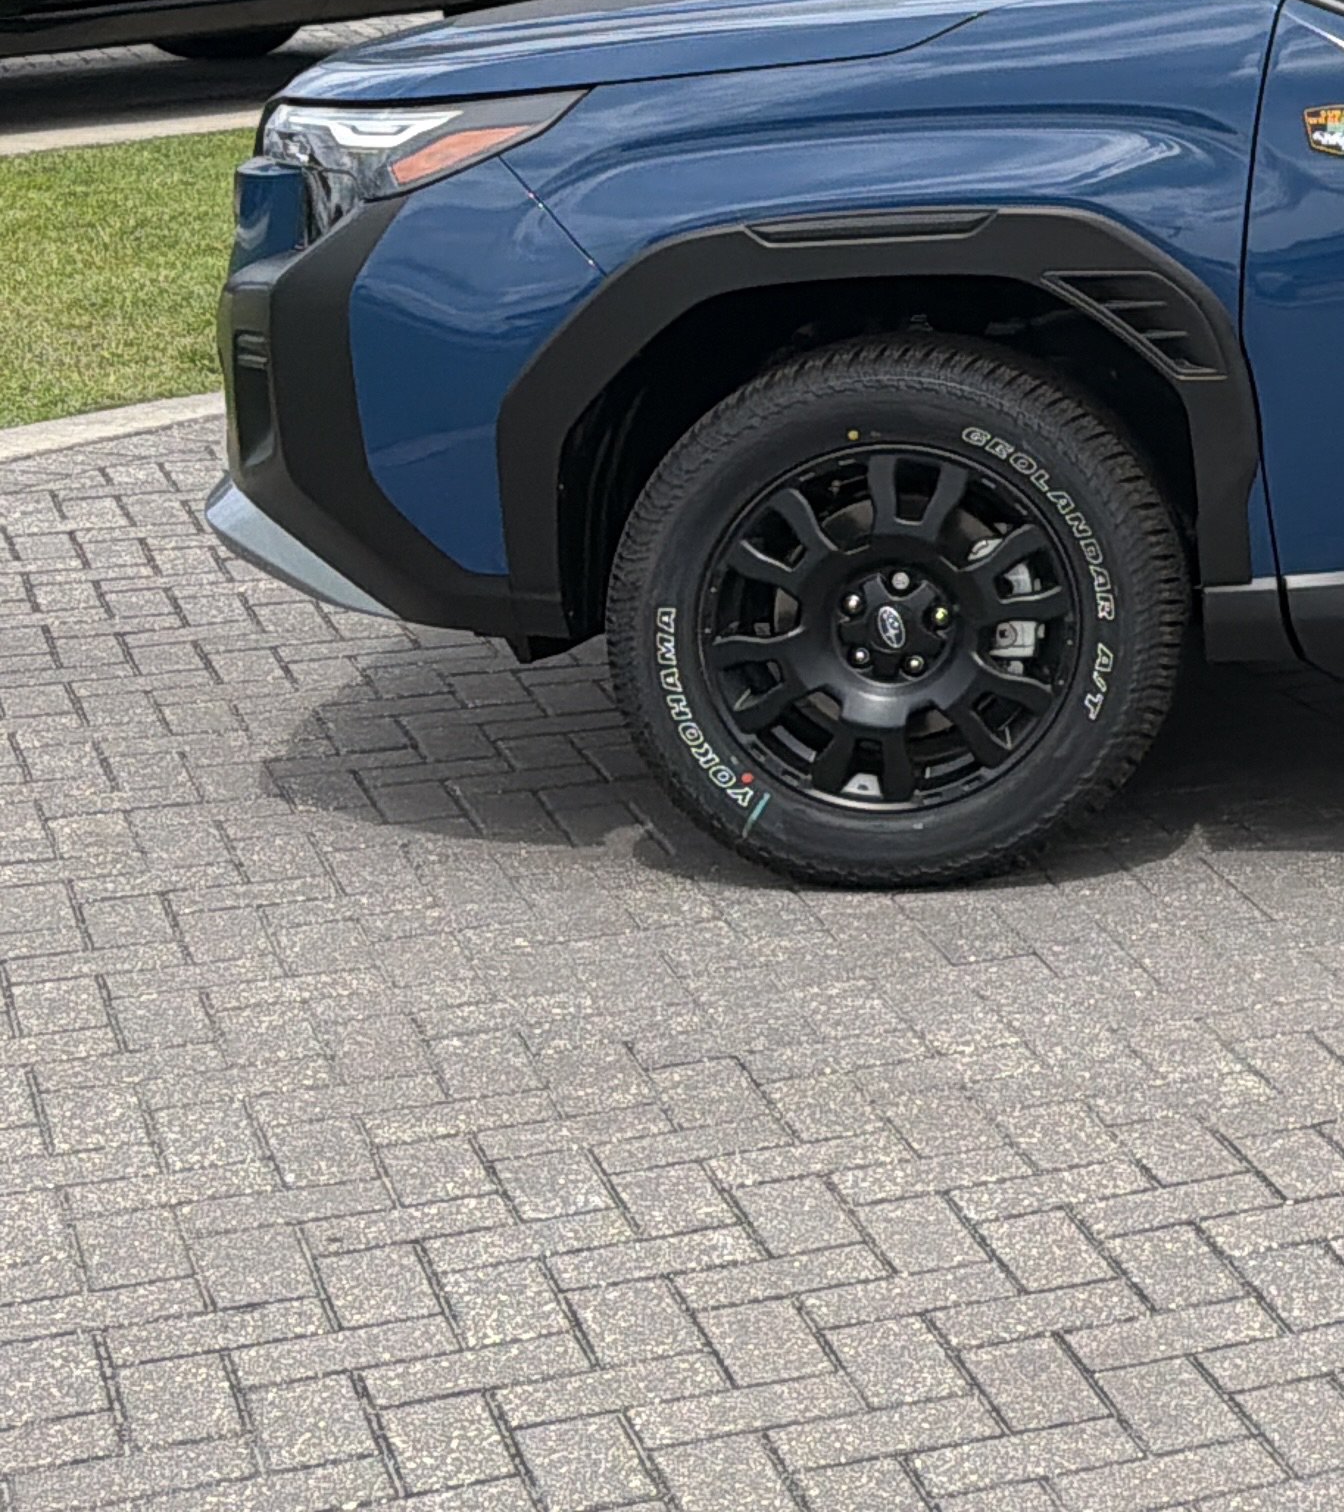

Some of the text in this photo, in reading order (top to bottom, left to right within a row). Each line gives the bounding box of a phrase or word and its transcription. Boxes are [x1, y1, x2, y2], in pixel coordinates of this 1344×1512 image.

[961, 427, 1115, 720] GEOLANDAR A/T
[656, 607, 753, 806] YOKOHAMA
